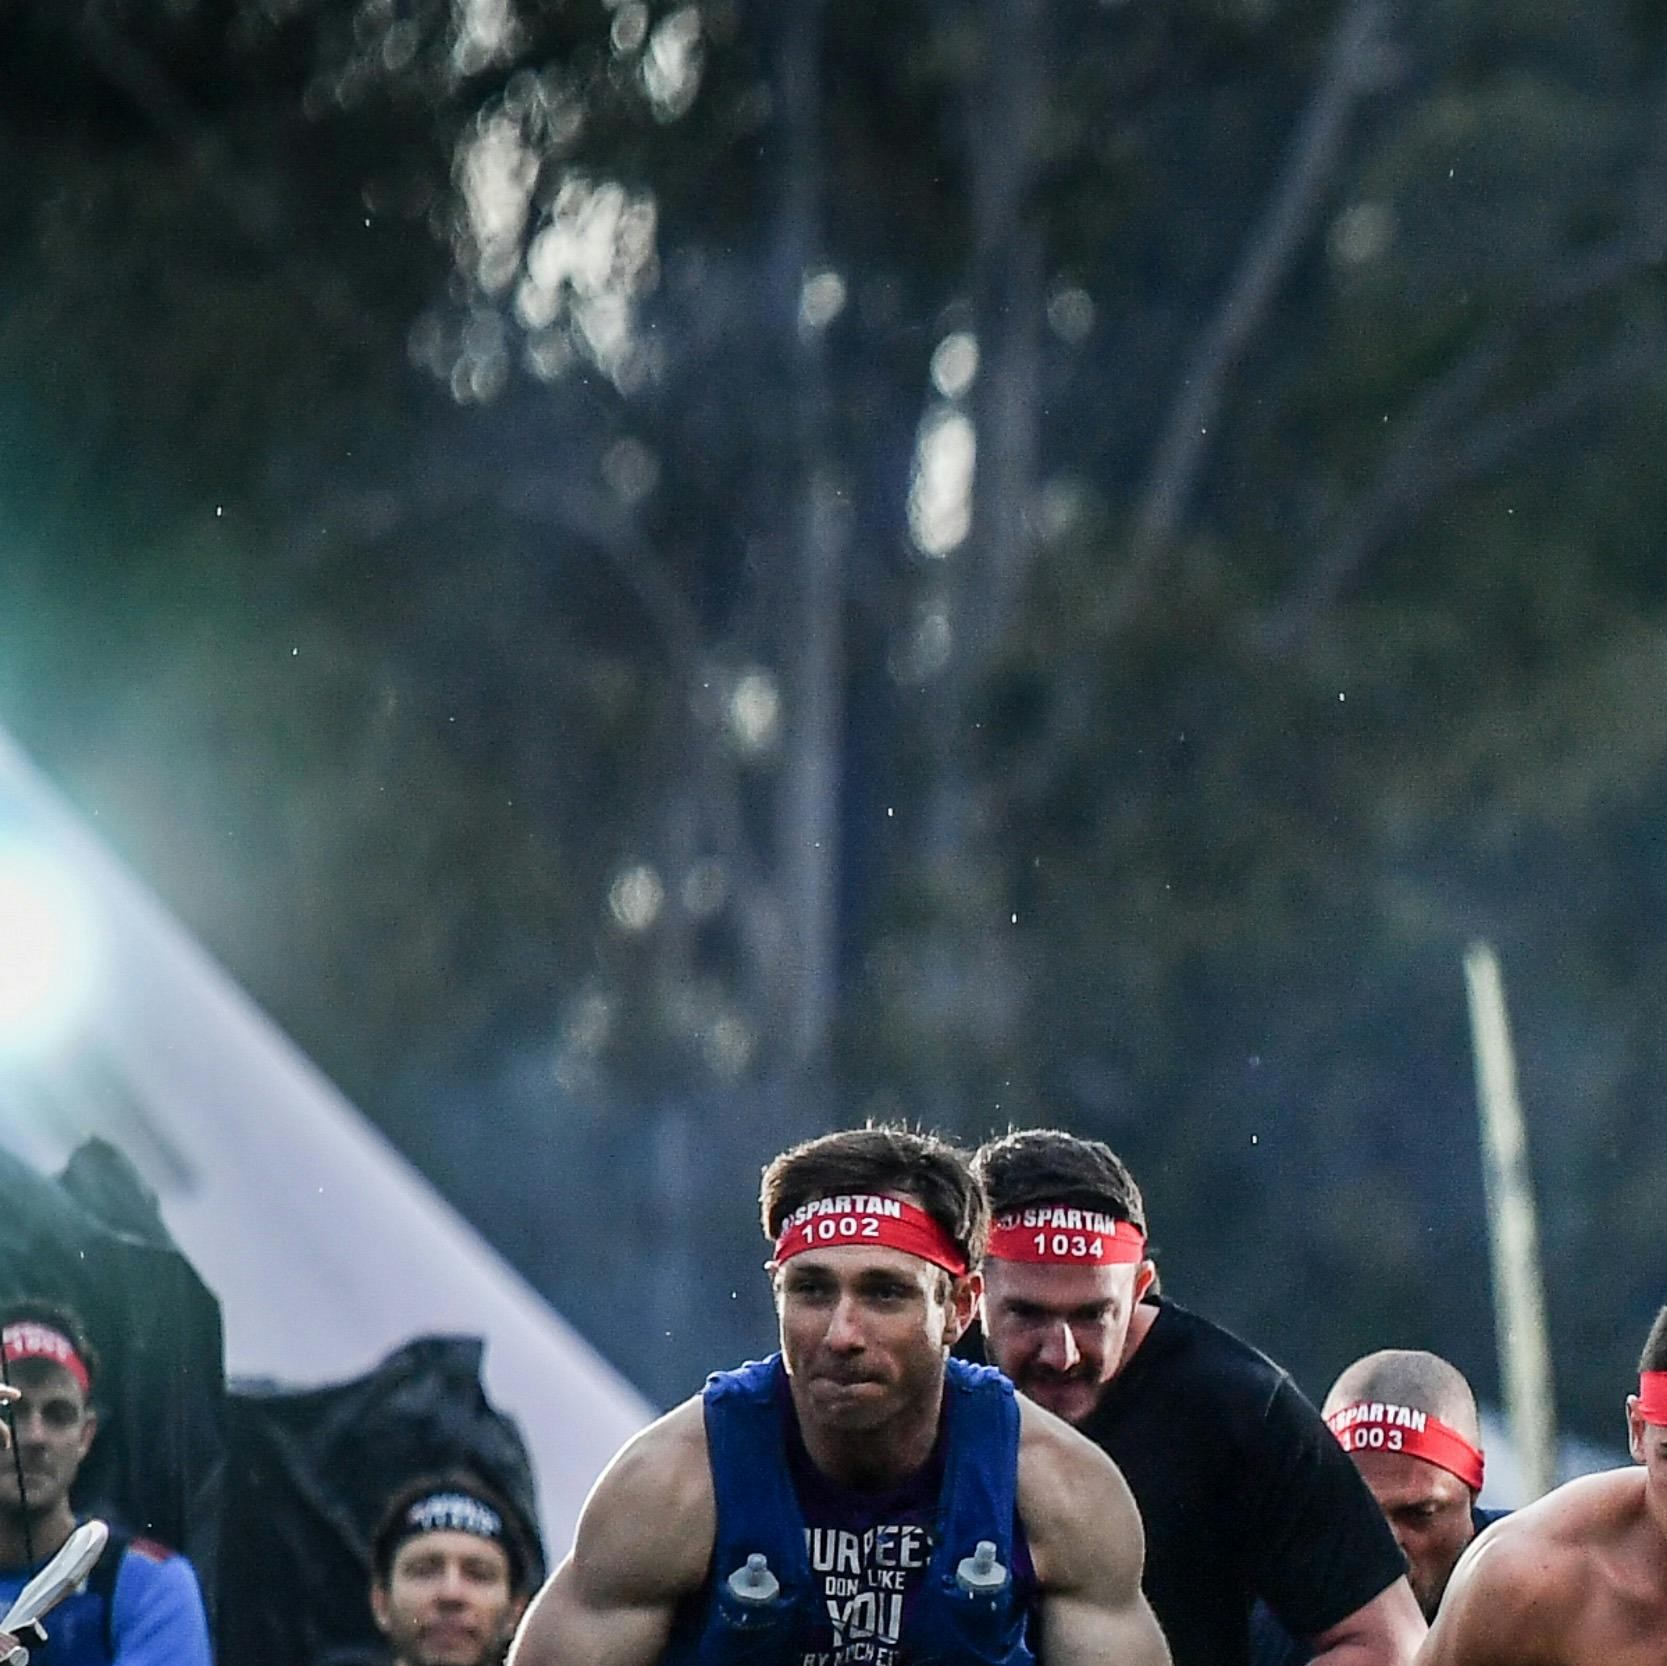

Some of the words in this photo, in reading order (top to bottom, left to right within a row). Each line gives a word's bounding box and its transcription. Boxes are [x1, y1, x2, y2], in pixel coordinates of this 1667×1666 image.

[794, 1195, 901, 1227] SPARTAN
[1023, 1208, 1116, 1235] SPARTAN
[802, 1217, 879, 1244] 1002
[1033, 1233, 1104, 1258] 1034
[1334, 1402, 1427, 1433] SPARTAN
[1340, 1427, 1403, 1452] 1003
[867, 1569, 906, 1590] LIKE
[826, 1592, 903, 1648] YOU
